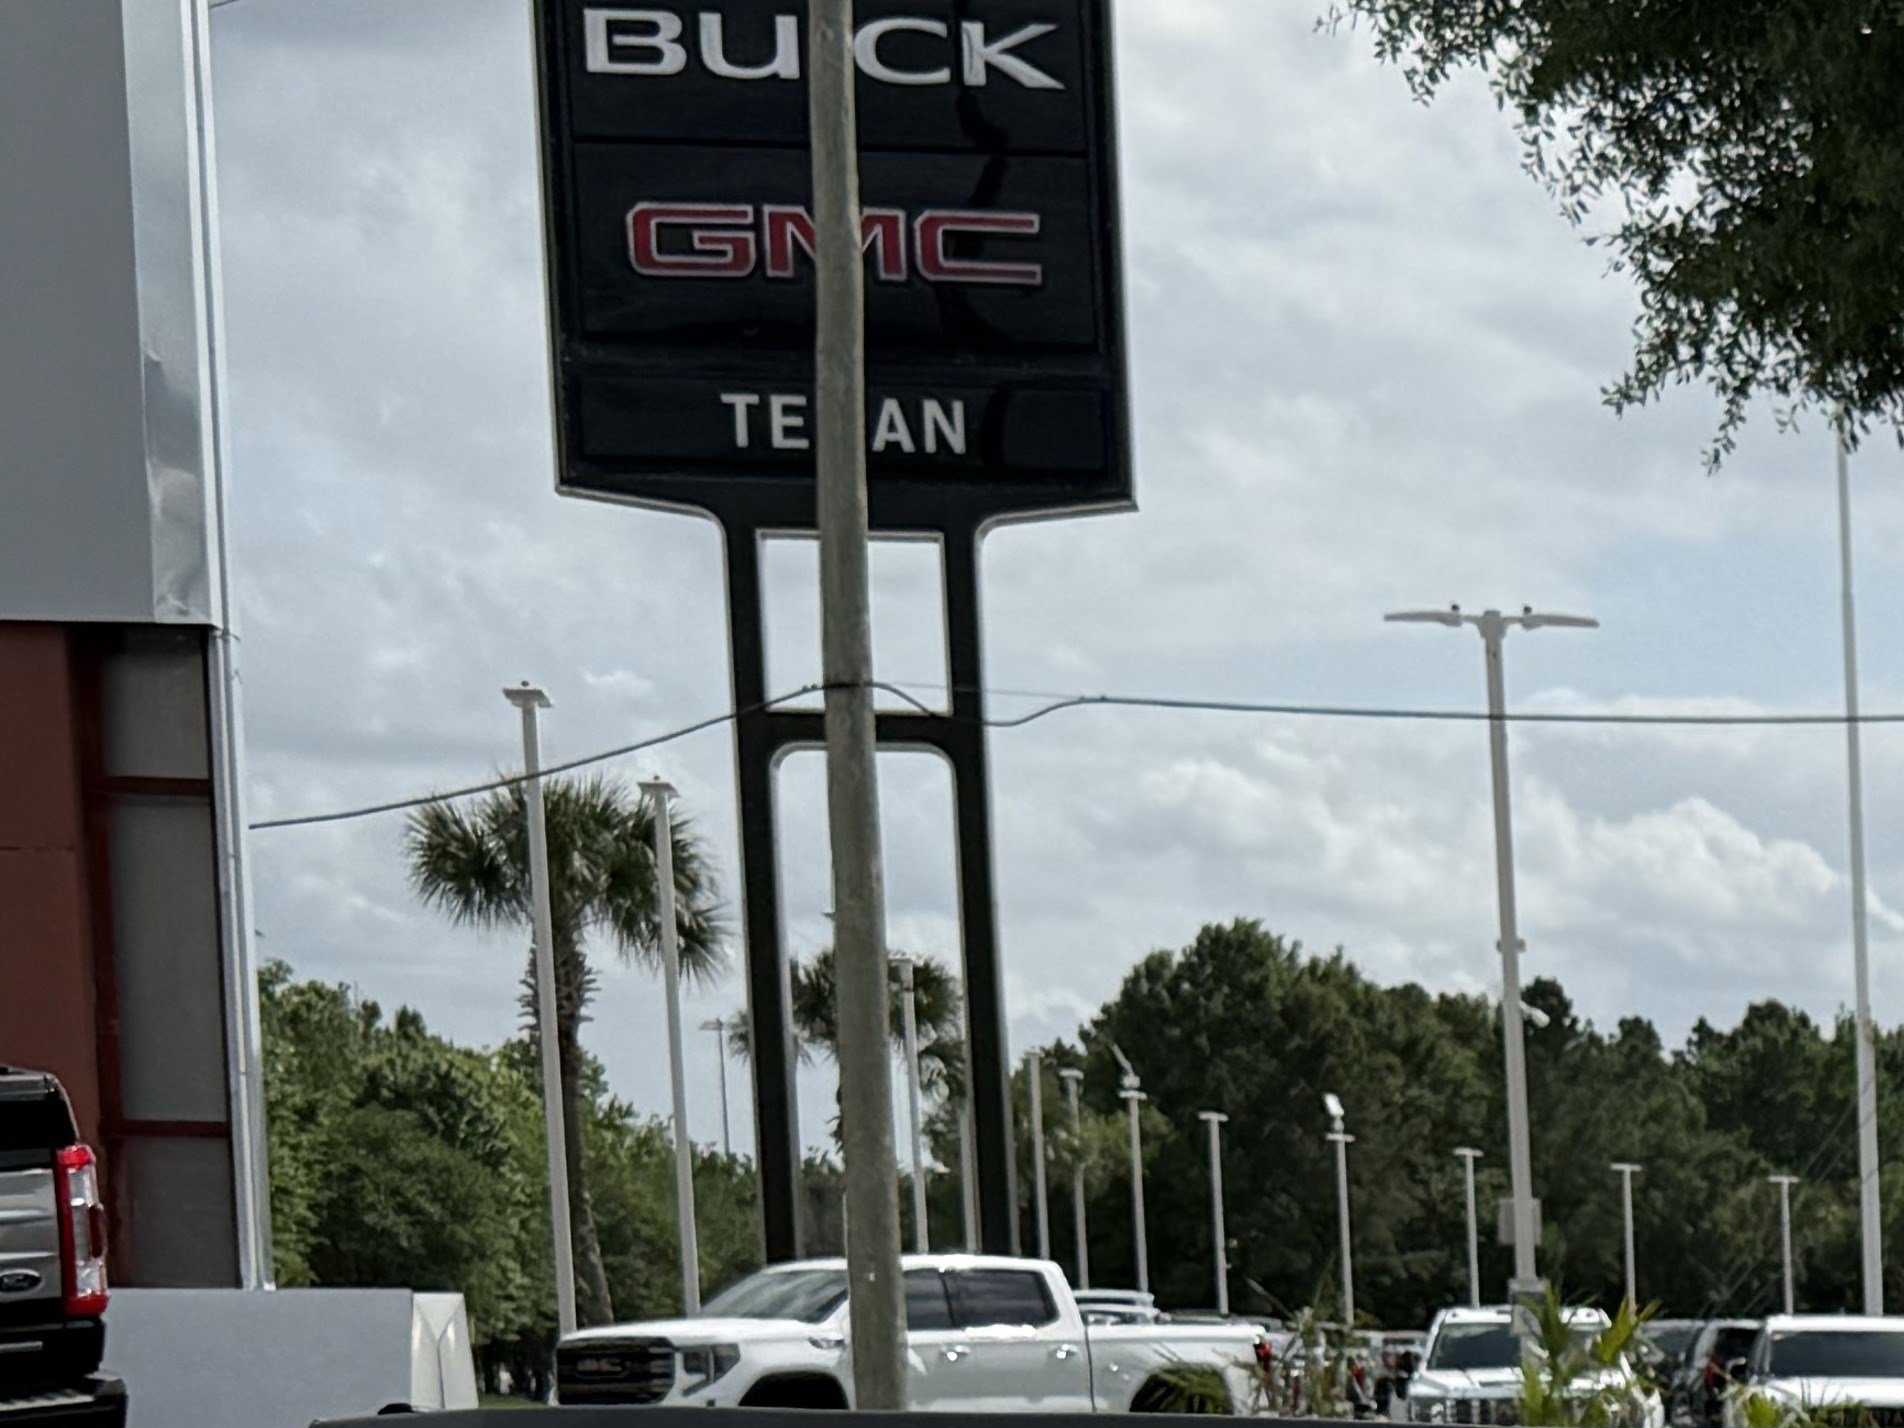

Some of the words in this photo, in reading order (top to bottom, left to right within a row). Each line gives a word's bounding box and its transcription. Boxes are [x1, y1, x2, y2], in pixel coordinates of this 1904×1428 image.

[584, 8, 1066, 90] BUCK
[627, 202, 1042, 285] GMC
[720, 393, 967, 455] TEAN
